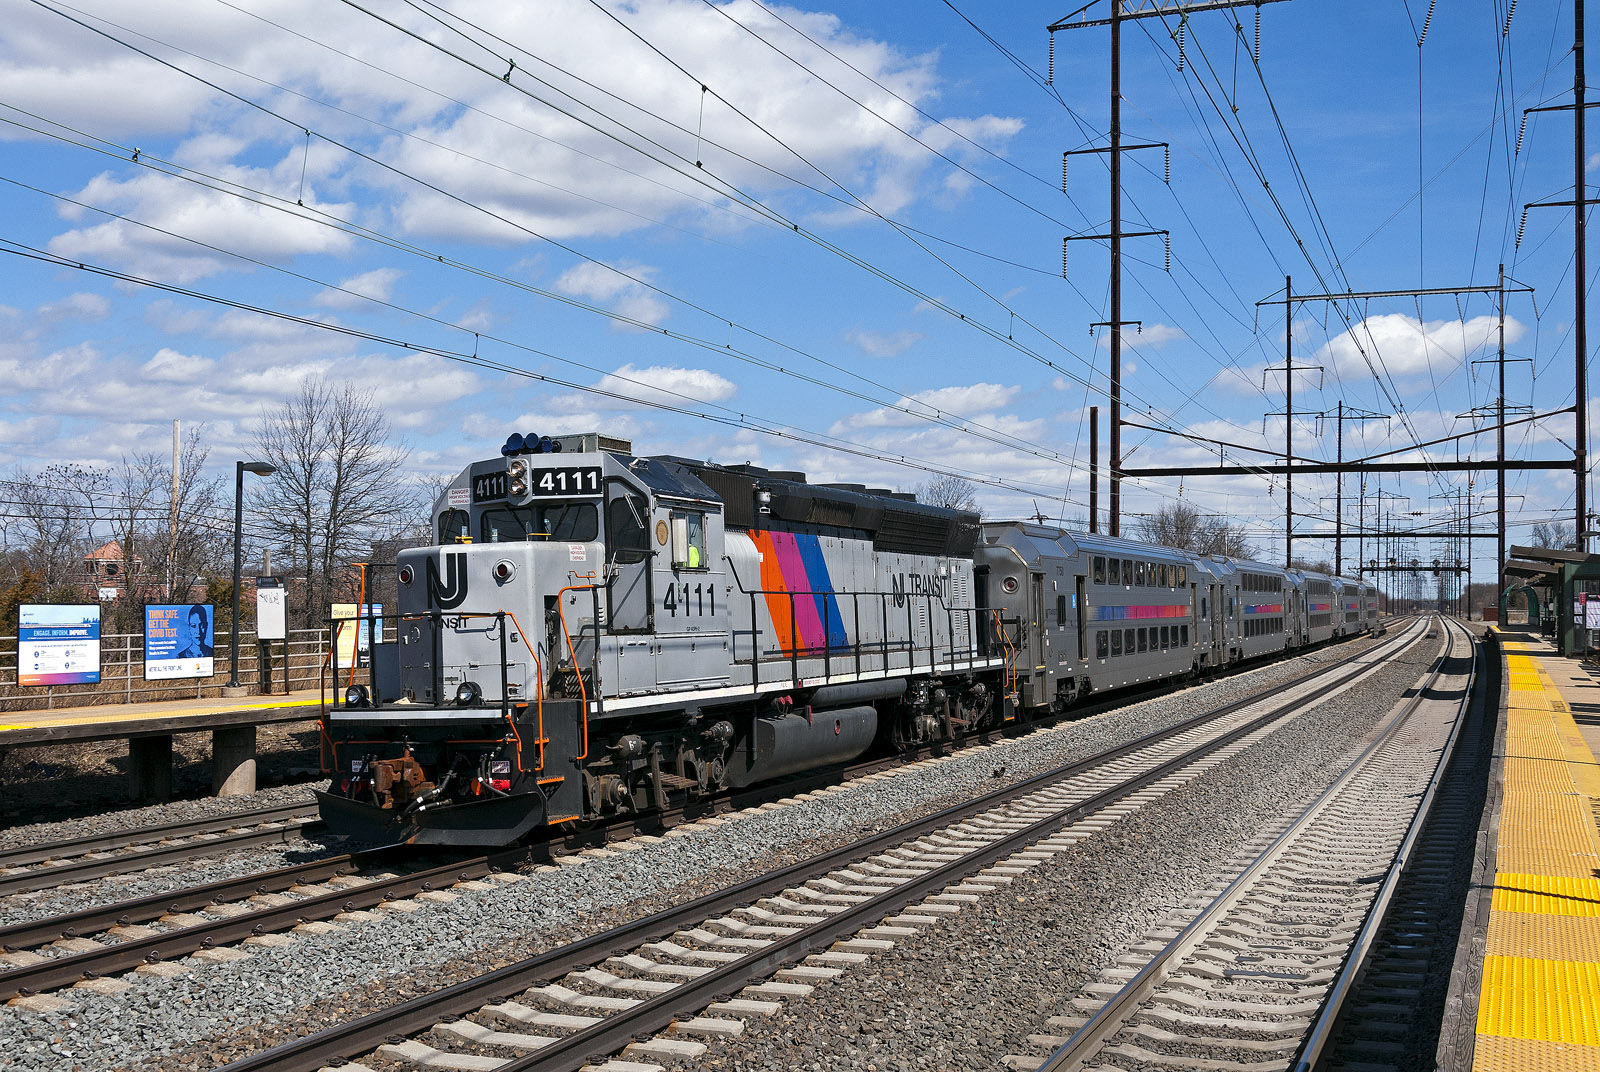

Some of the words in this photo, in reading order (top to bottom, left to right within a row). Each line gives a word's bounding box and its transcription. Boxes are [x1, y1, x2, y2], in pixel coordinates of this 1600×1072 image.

[476, 475, 504, 497] 4111
[539, 471, 597, 490] 4111
[663, 582, 715, 617] 4111
[892, 572, 904, 608] NJ
[909, 573, 947, 598] TRANSIT
[148, 610, 164, 619] THINK
[165, 609, 179, 618] SAFE.
[148, 620, 158, 628] GET
[159, 619, 169, 628] THE
[148, 629, 164, 638] COVID
